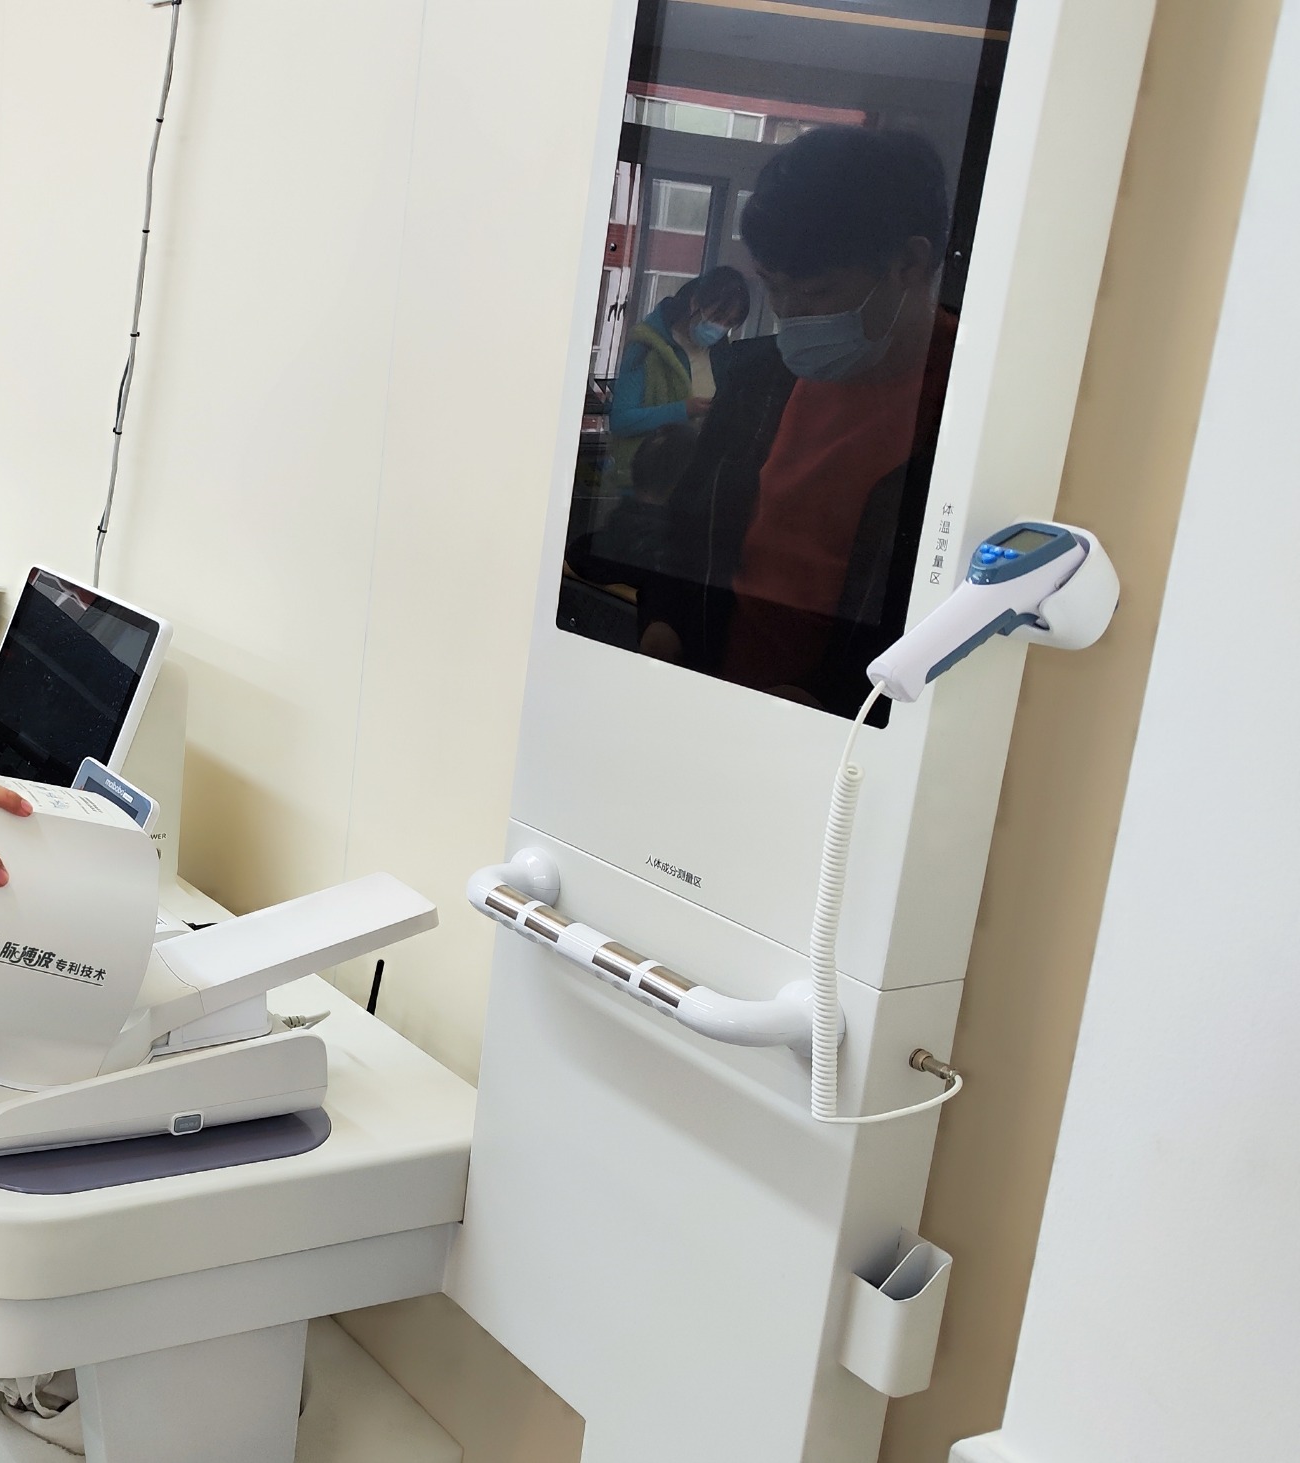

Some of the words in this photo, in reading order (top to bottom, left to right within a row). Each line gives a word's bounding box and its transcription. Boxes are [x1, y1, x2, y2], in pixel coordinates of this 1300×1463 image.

[929, 502, 954, 585] 体温测量区
[645, 855, 702, 889] 人体成分测量区
